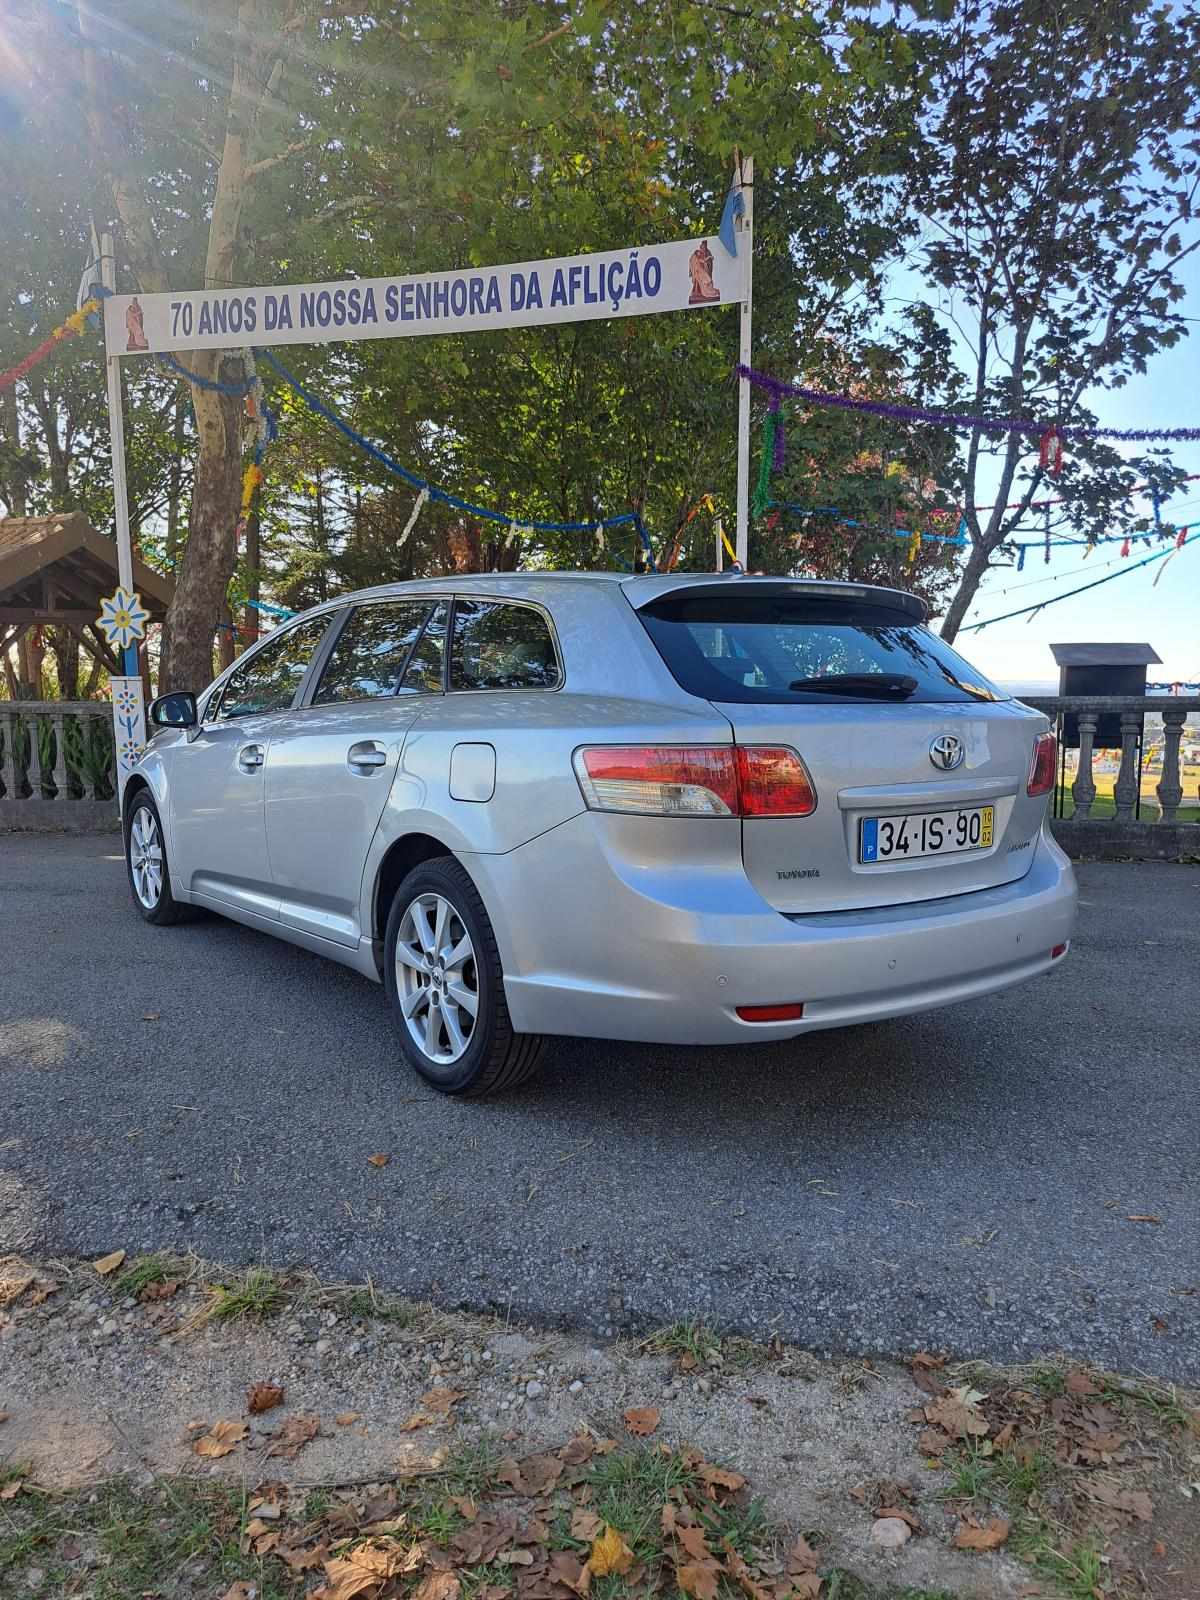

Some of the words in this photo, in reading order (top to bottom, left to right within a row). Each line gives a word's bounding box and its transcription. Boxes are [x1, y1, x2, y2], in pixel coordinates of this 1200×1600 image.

[171, 301, 193, 337] 70
[198, 297, 257, 335] ANOS
[264, 294, 293, 330] DA
[300, 287, 378, 328] NOSSA
[385, 275, 503, 322] SENHORA
[510, 271, 543, 311] DA
[550, 252, 662, 312] AFLIÇÃO
[983, 811, 992, 823] 10
[982, 831, 991, 842] 02
[867, 845, 874, 854] P
